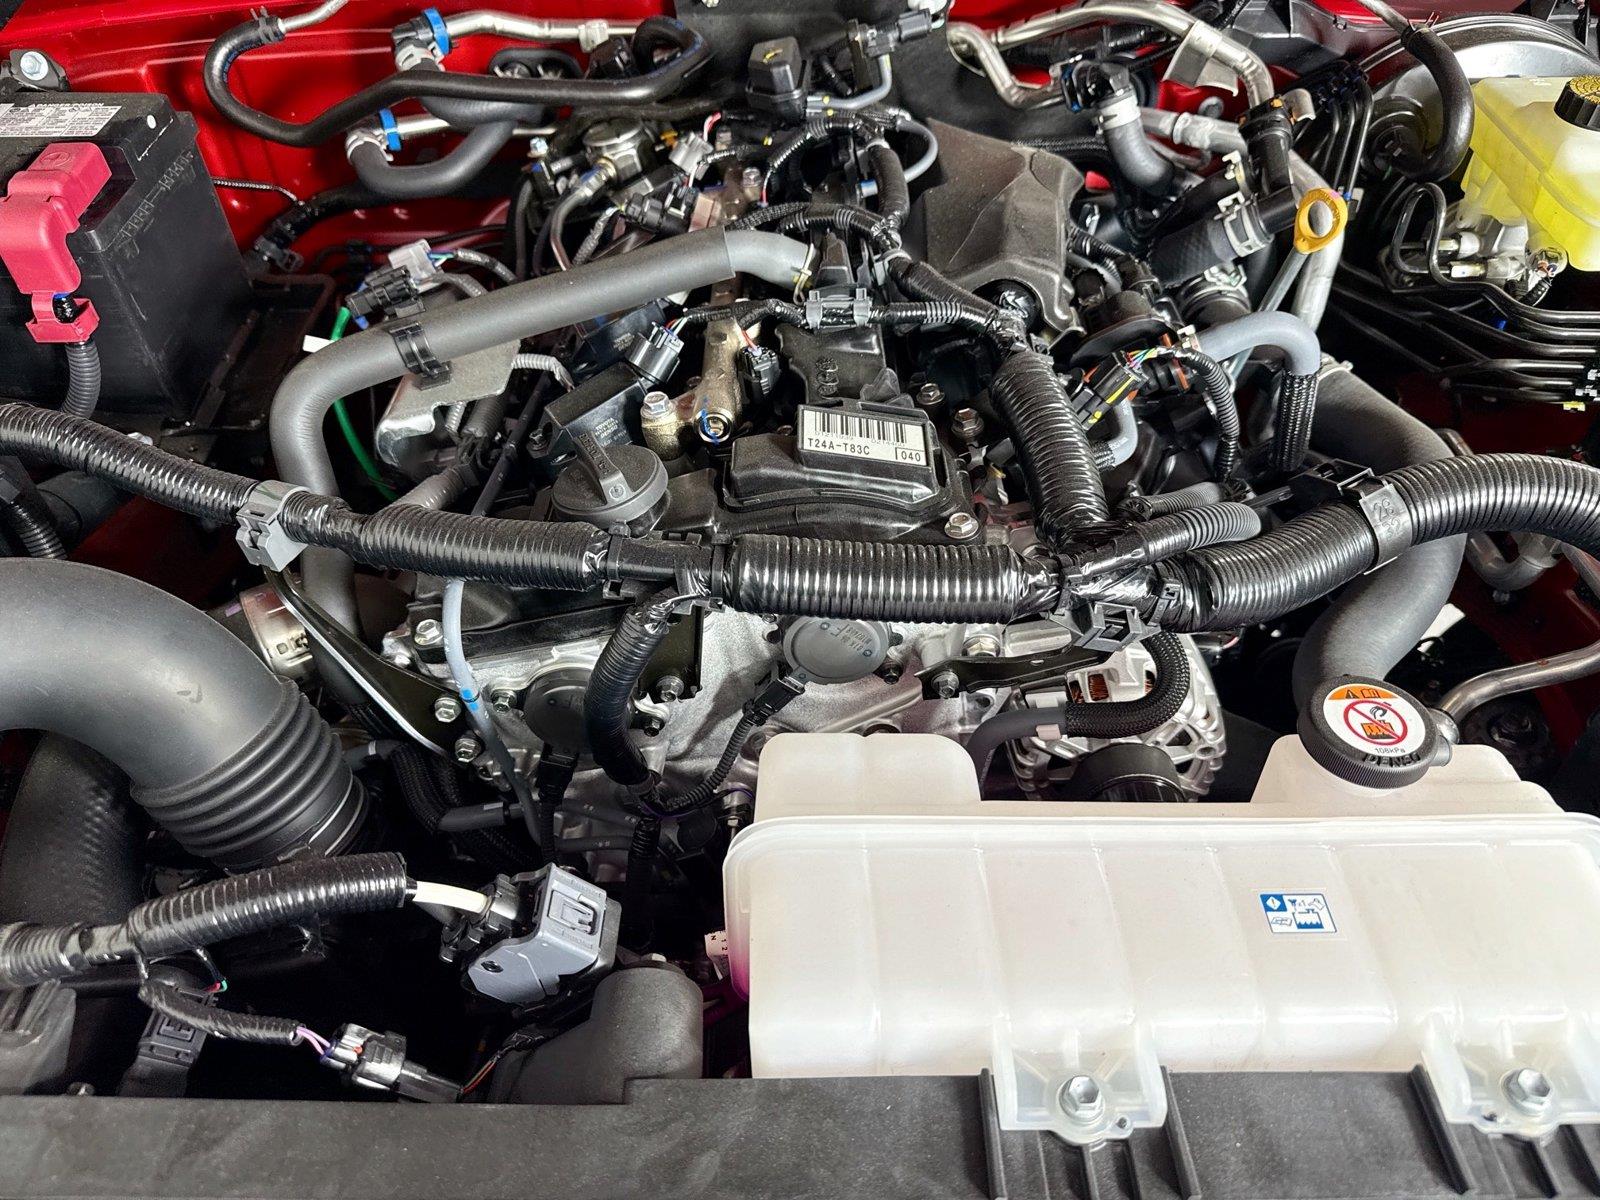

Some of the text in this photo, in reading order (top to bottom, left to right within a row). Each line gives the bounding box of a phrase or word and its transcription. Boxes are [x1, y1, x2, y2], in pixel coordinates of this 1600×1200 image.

[807, 437, 870, 455] T24A-T83C
[901, 450, 921, 462] 040
[1362, 752, 1420, 767] DENSO
